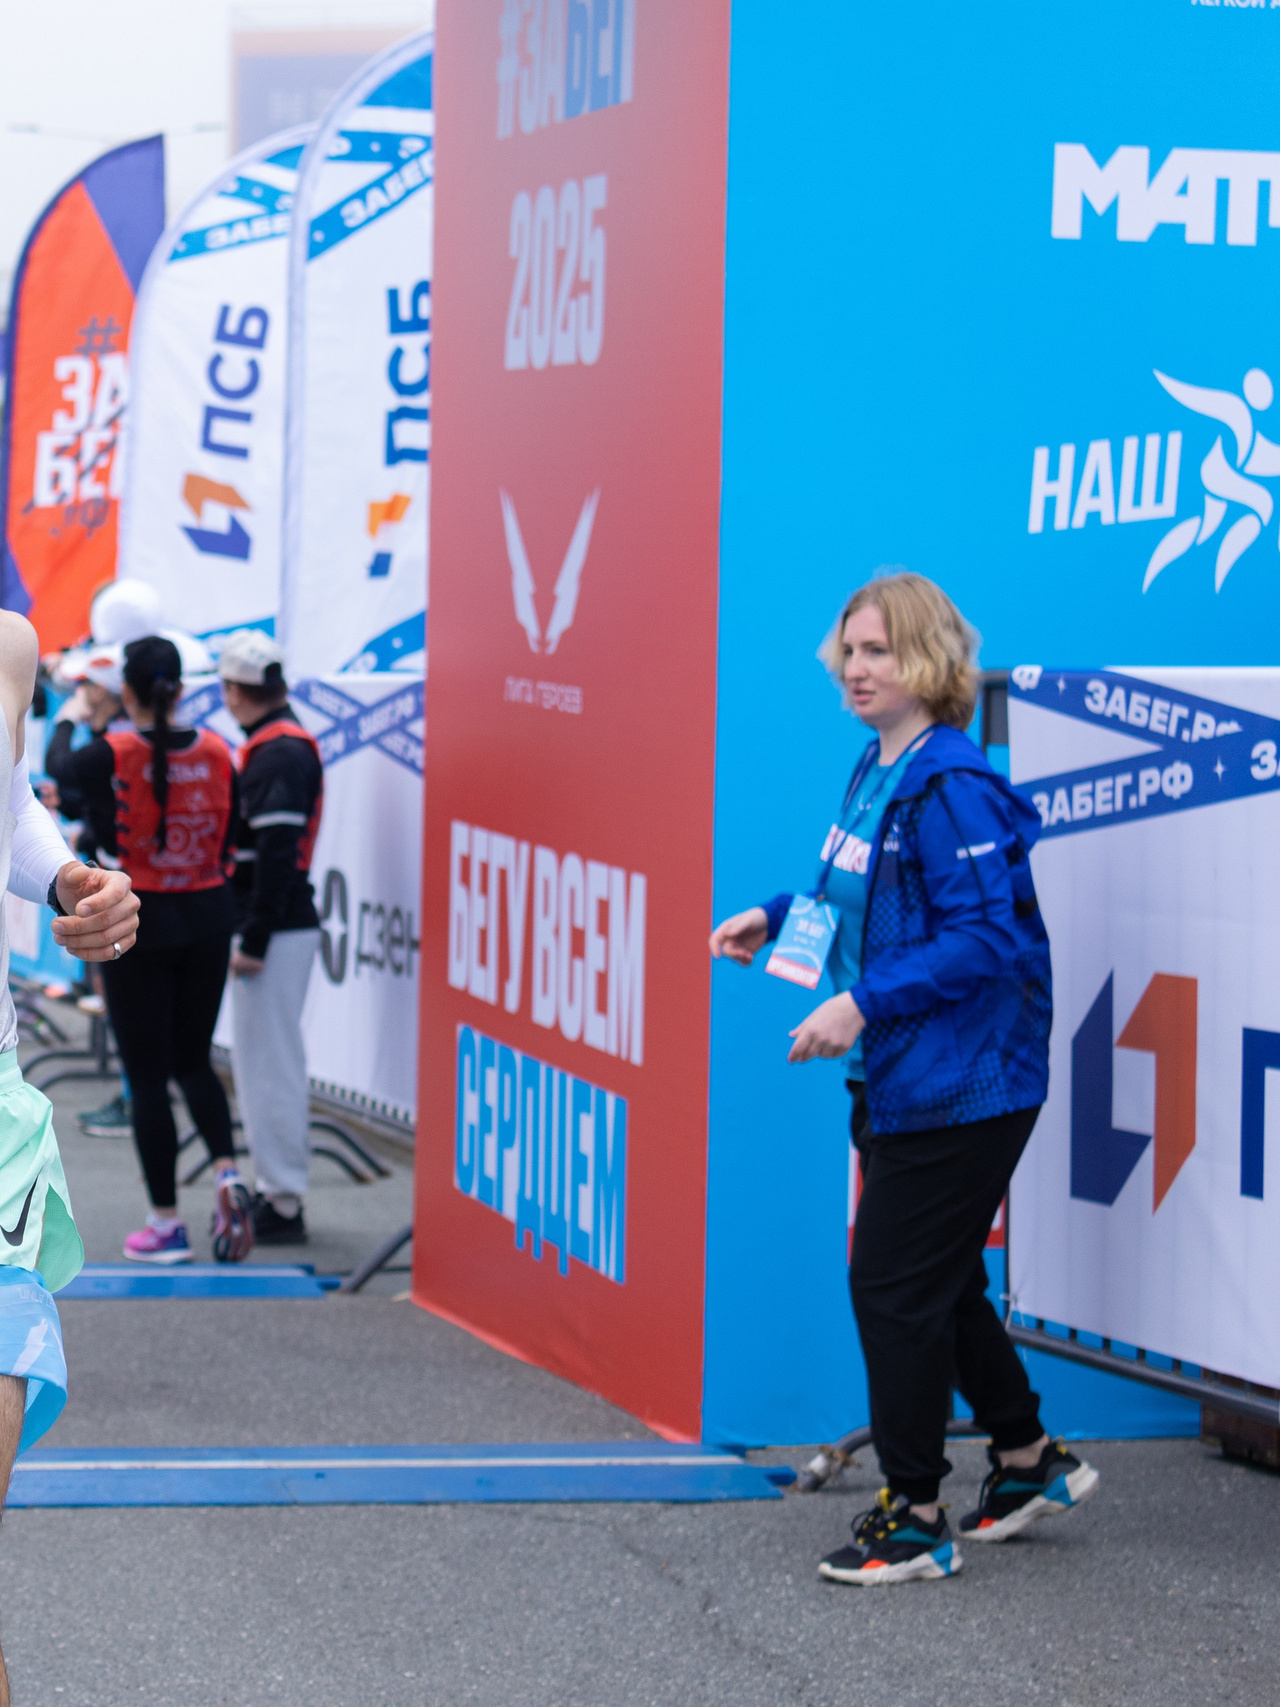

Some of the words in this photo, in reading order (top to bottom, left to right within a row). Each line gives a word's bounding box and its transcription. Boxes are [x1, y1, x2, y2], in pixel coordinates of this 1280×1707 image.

[504, 173, 608, 371] 2025
[1051, 142, 1280, 246] МАТ
[201, 304, 270, 460] ПСБ
[1028, 430, 1182, 534] НАШ
[447, 818, 530, 1015] БЕГУ
[531, 844, 647, 1067] ВСЕМ
[453, 1022, 628, 1286] СЕРДЦЕМ
